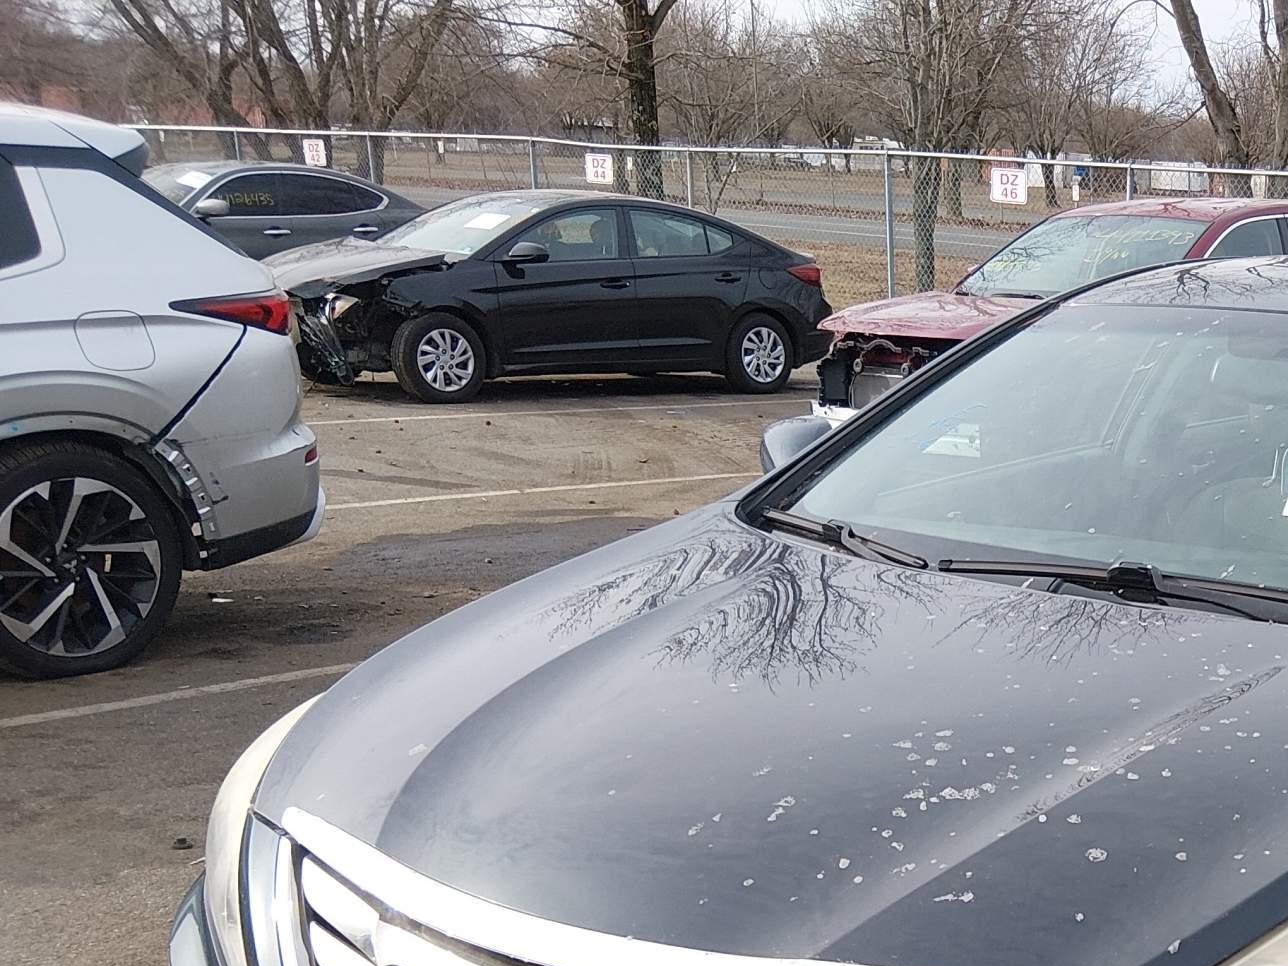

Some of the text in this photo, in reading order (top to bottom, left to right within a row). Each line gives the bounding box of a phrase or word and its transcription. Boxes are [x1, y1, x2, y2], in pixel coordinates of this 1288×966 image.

[592, 158, 606, 169] DZ
[593, 170, 606, 180] 44
[1000, 174, 1019, 186] DZ
[1001, 187, 1018, 199] 46
